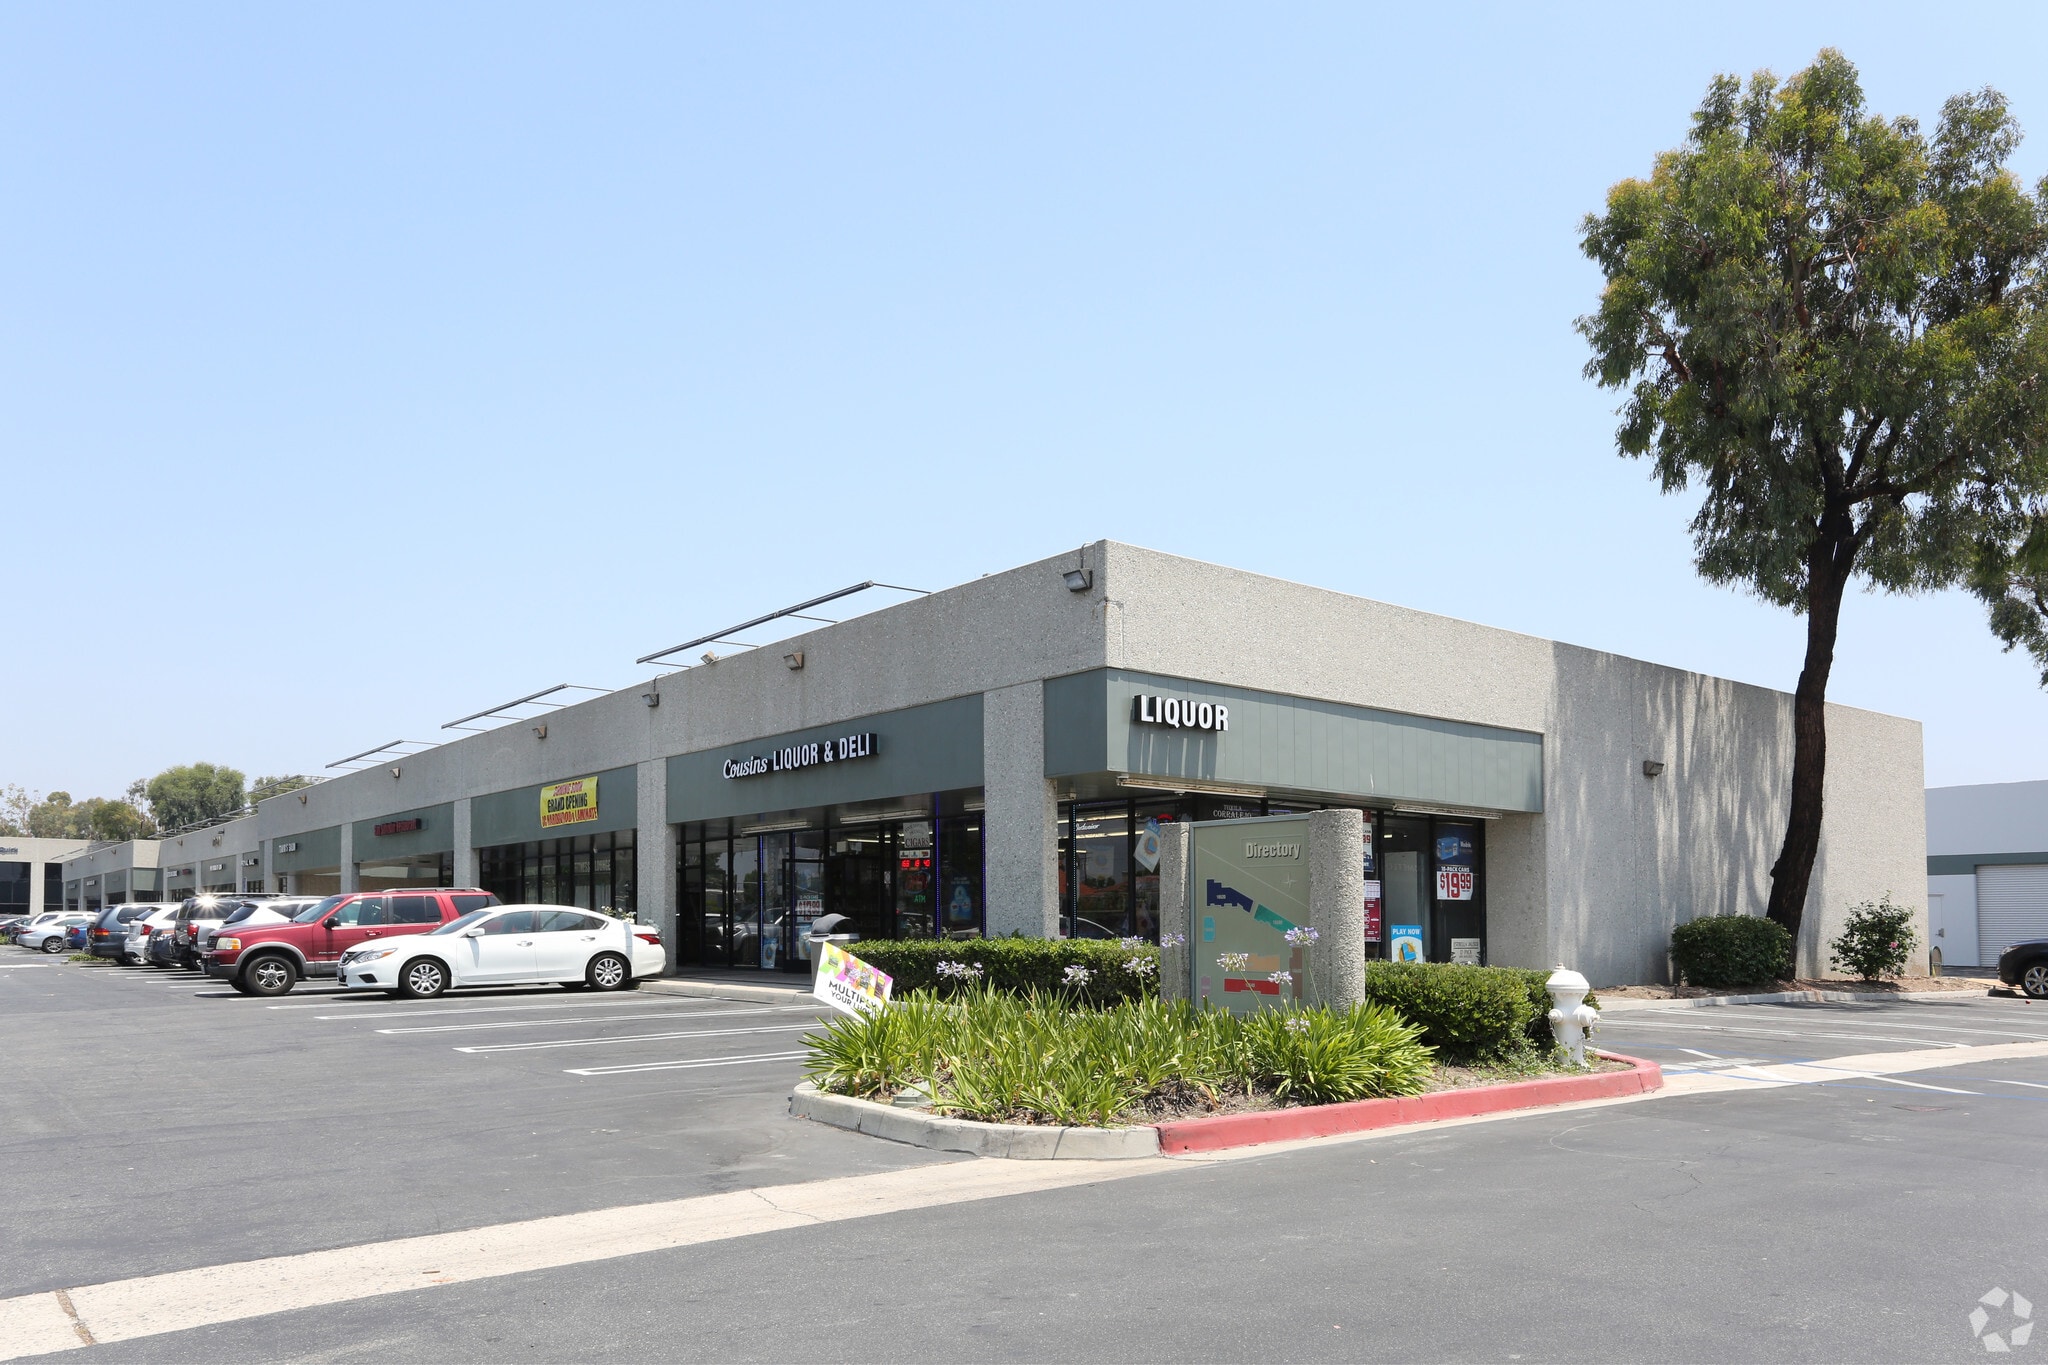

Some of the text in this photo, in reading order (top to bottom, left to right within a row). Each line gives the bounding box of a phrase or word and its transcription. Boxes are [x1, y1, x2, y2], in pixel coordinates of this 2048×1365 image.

[1140, 694, 1229, 731] LIQUOR
[723, 732, 870, 779] Cousins LIQUOR & DELI
[548, 792, 587, 812] GRAND OPENING
[906, 838, 930, 847] CIGARS
[1246, 842, 1301, 860] Directory
[914, 895, 926, 903] ATM
[831, 991, 852, 1005] YOUR
